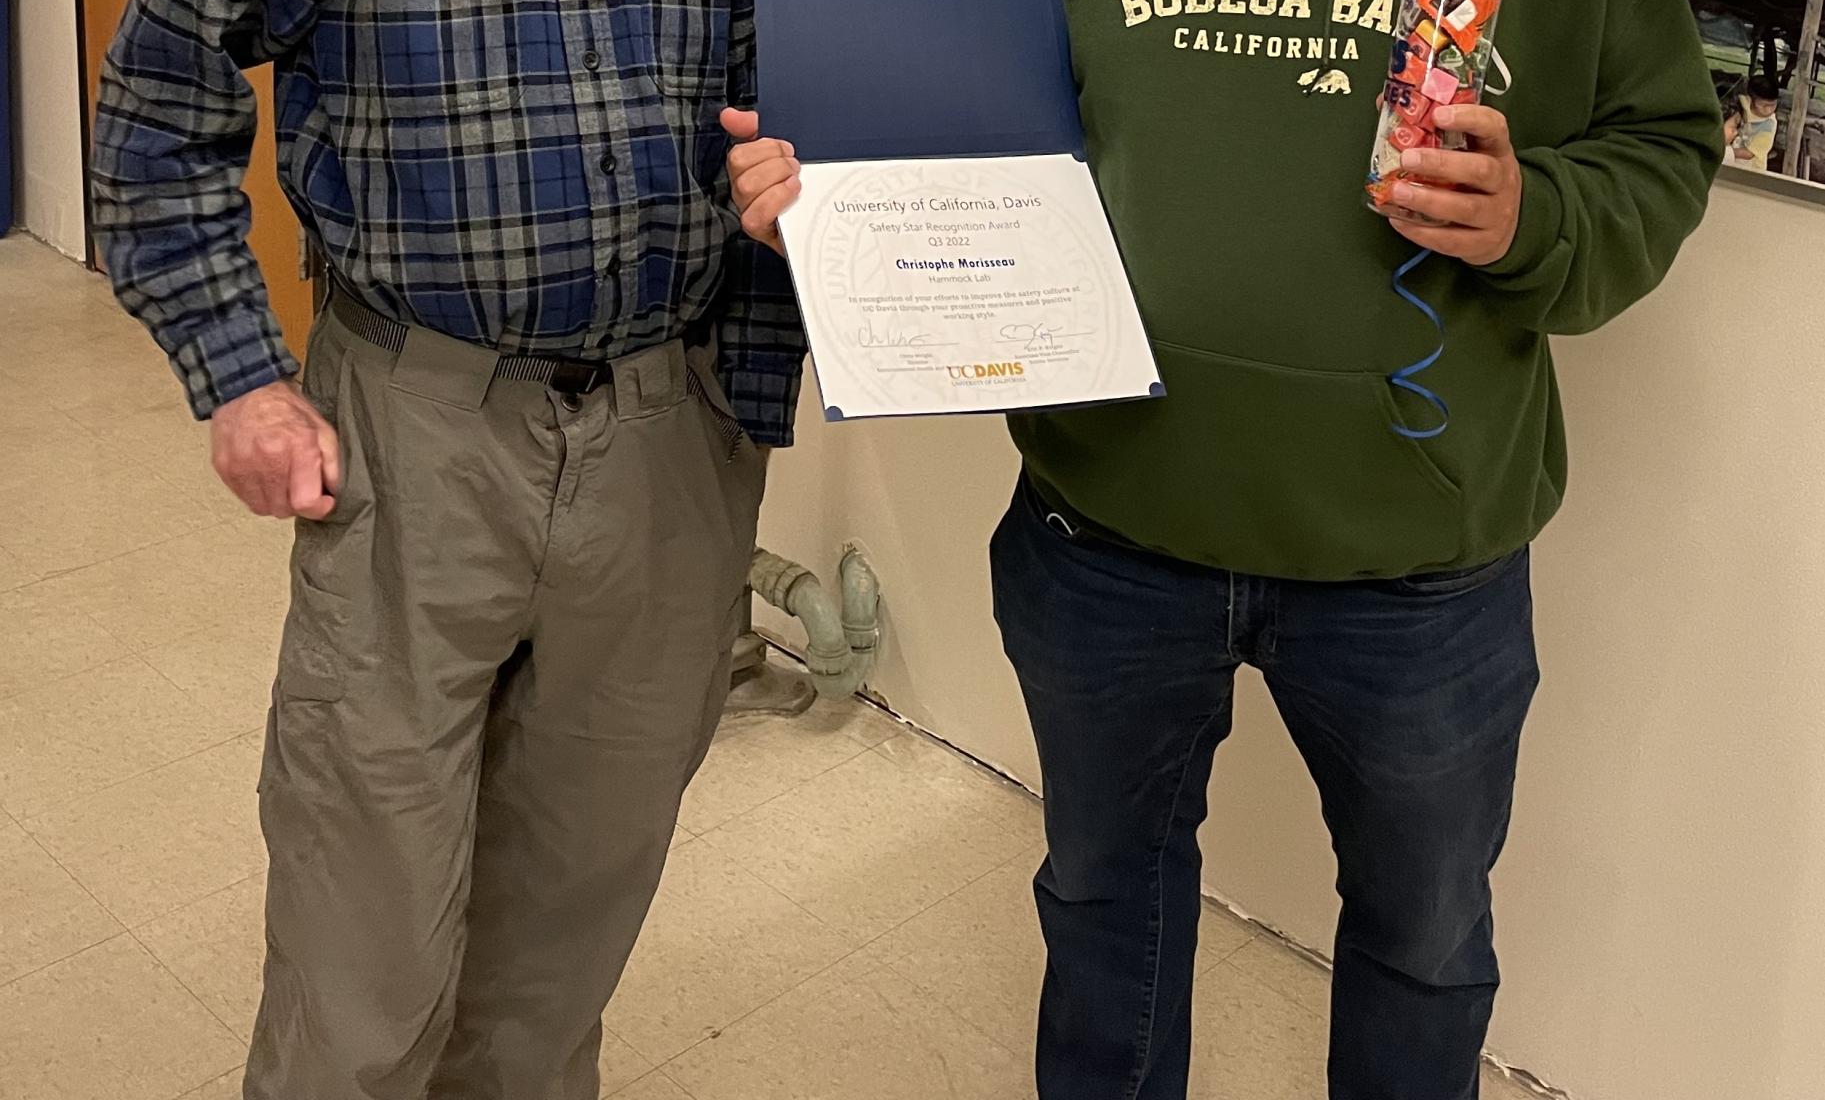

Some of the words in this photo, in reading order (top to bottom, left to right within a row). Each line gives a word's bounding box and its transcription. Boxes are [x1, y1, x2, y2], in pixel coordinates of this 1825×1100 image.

[1174, 27, 1359, 61] CALIFORNIA
[834, 199, 906, 215] University
[911, 199, 925, 211] of
[929, 197, 1000, 212] California,
[1003, 195, 1041, 210] Davis
[868, 222, 901, 234] Safety
[903, 222, 923, 232] Star
[927, 221, 985, 234] Recognition
[988, 220, 1020, 230] Award
[928, 237, 943, 247] Q3
[946, 237, 971, 247] 2022
[896, 259, 954, 272] Christophe
[958, 257, 1015, 269] Morisseau
[929, 275, 972, 284] Hammock
[975, 274, 991, 283] Lab
[860, 296, 903, 304] recognition
[971, 293, 1001, 301] improve
[1003, 291, 1016, 299] the
[931, 304, 948, 312] your
